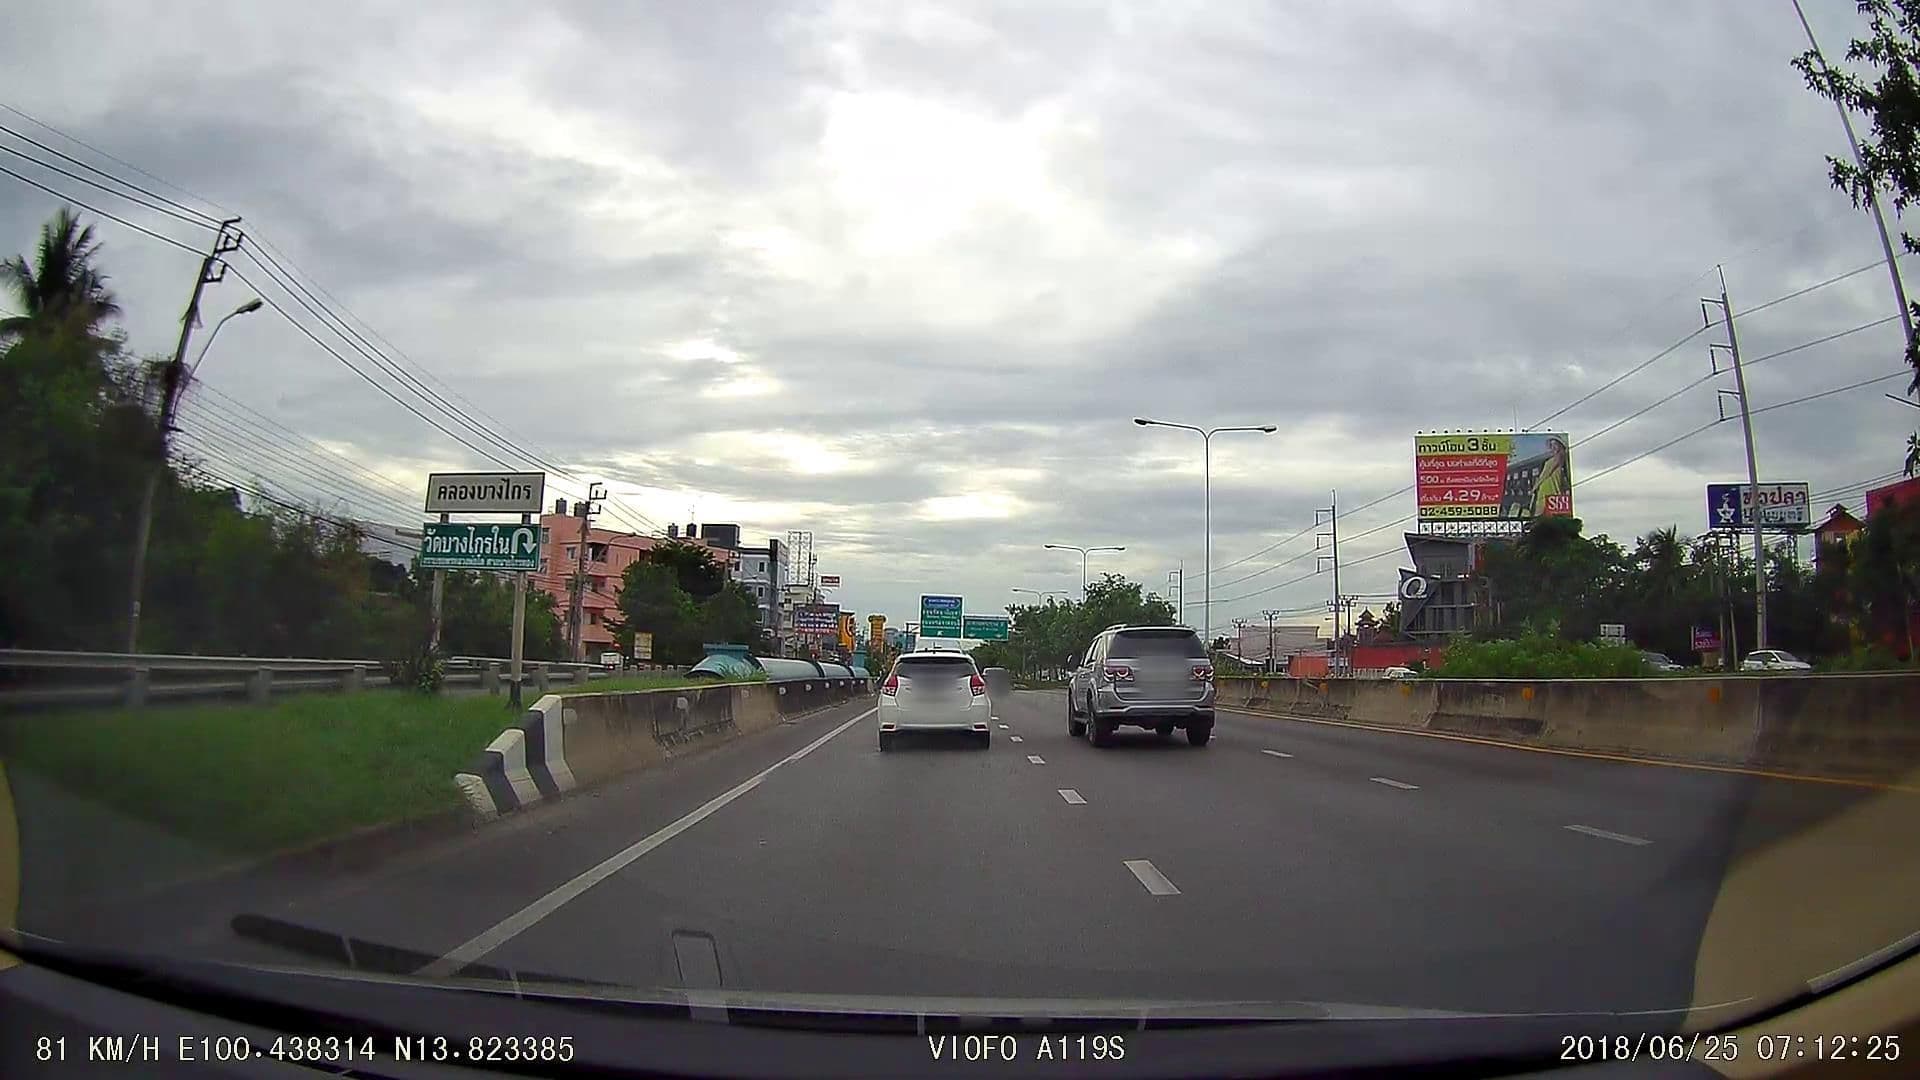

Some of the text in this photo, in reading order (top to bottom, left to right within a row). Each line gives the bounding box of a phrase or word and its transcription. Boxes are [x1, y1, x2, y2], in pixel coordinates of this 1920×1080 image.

[1419, 438, 1497, 453] ทาวน์โฮม 3 ชั้น
[1420, 475, 1439, 484] 500
[438, 479, 532, 500] คลองบางไกร
[1443, 489, 1481, 502] 4.29
[424, 526, 510, 554] วัดบางไกรใน
